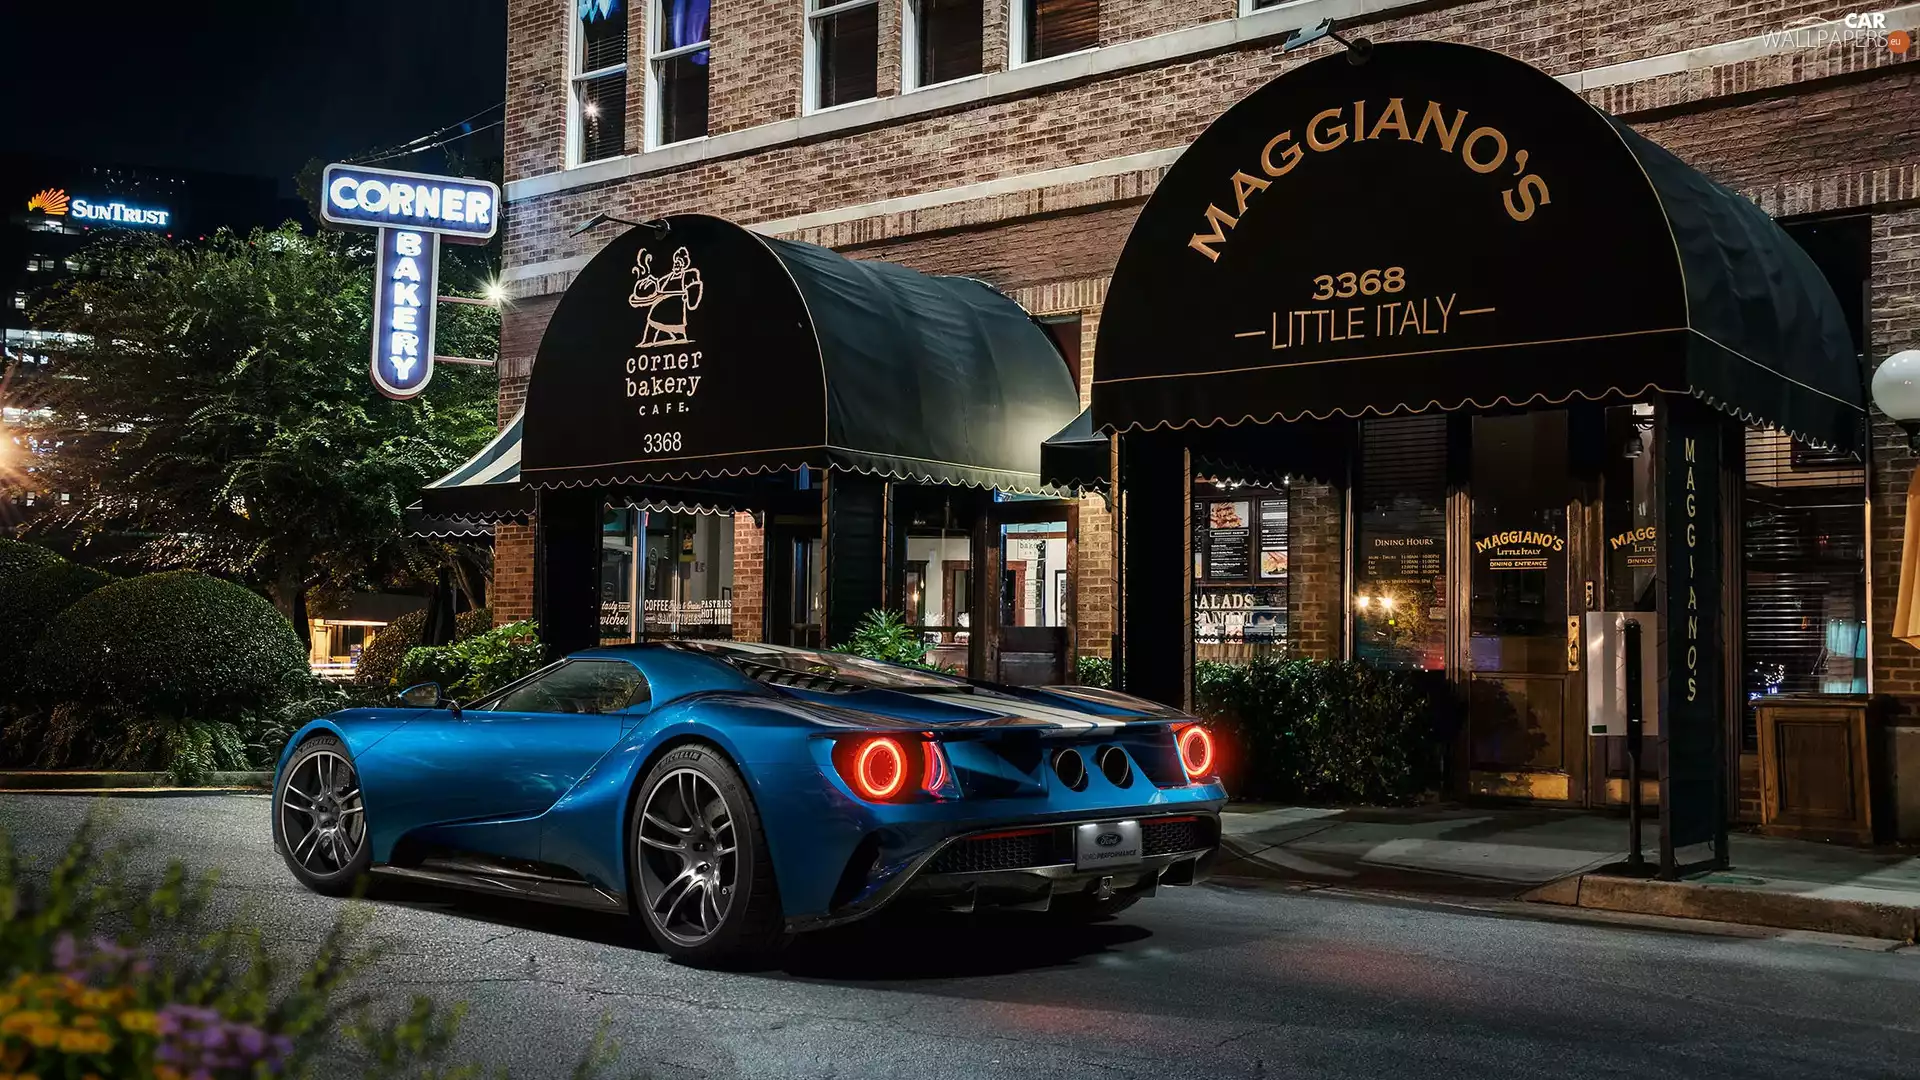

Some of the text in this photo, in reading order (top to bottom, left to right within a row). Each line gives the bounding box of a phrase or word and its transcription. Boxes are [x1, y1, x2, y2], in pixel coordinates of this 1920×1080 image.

[1188, 98, 1551, 263] MAGGIANO'S
[329, 177, 491, 224] CORNER
[1312, 267, 1406, 300] 3368
[389, 232, 422, 380] BAKERY
[1272, 293, 1457, 350] LITTLE ITALY
[626, 351, 702, 374] corner
[625, 376, 702, 397] bakery
[644, 431, 682, 453] 3368
[1375, 538, 1434, 547] DINING HOURS
[1475, 530, 1565, 553] MAGGIANO'S
[1685, 437, 1698, 701] MAGGIANO'S
[644, 600, 669, 611] COFFEE
[701, 600, 732, 608] PASTRIES
[1195, 593, 1254, 609] ALADS
[701, 608, 714, 618] HOT
